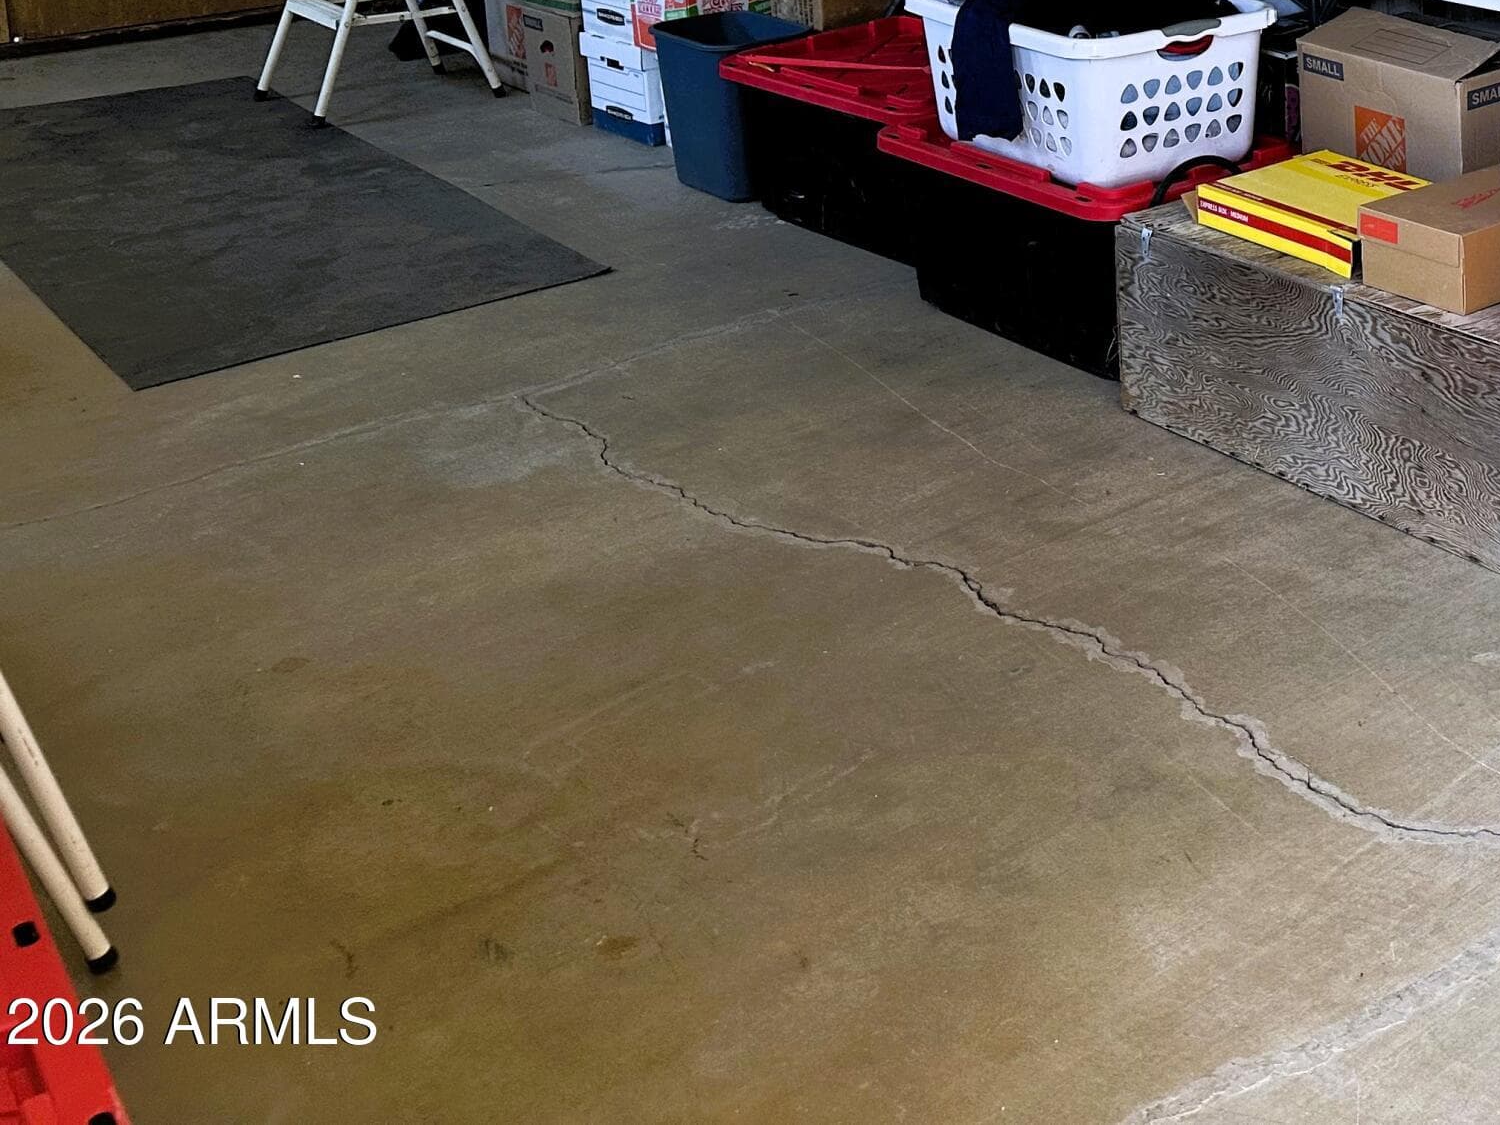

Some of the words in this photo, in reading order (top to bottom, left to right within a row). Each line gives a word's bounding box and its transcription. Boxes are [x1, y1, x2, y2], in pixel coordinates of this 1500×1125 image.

[1305, 57, 1341, 77] SMALL
[1360, 118, 1380, 144] THE
[1326, 161, 1421, 191] DHL
